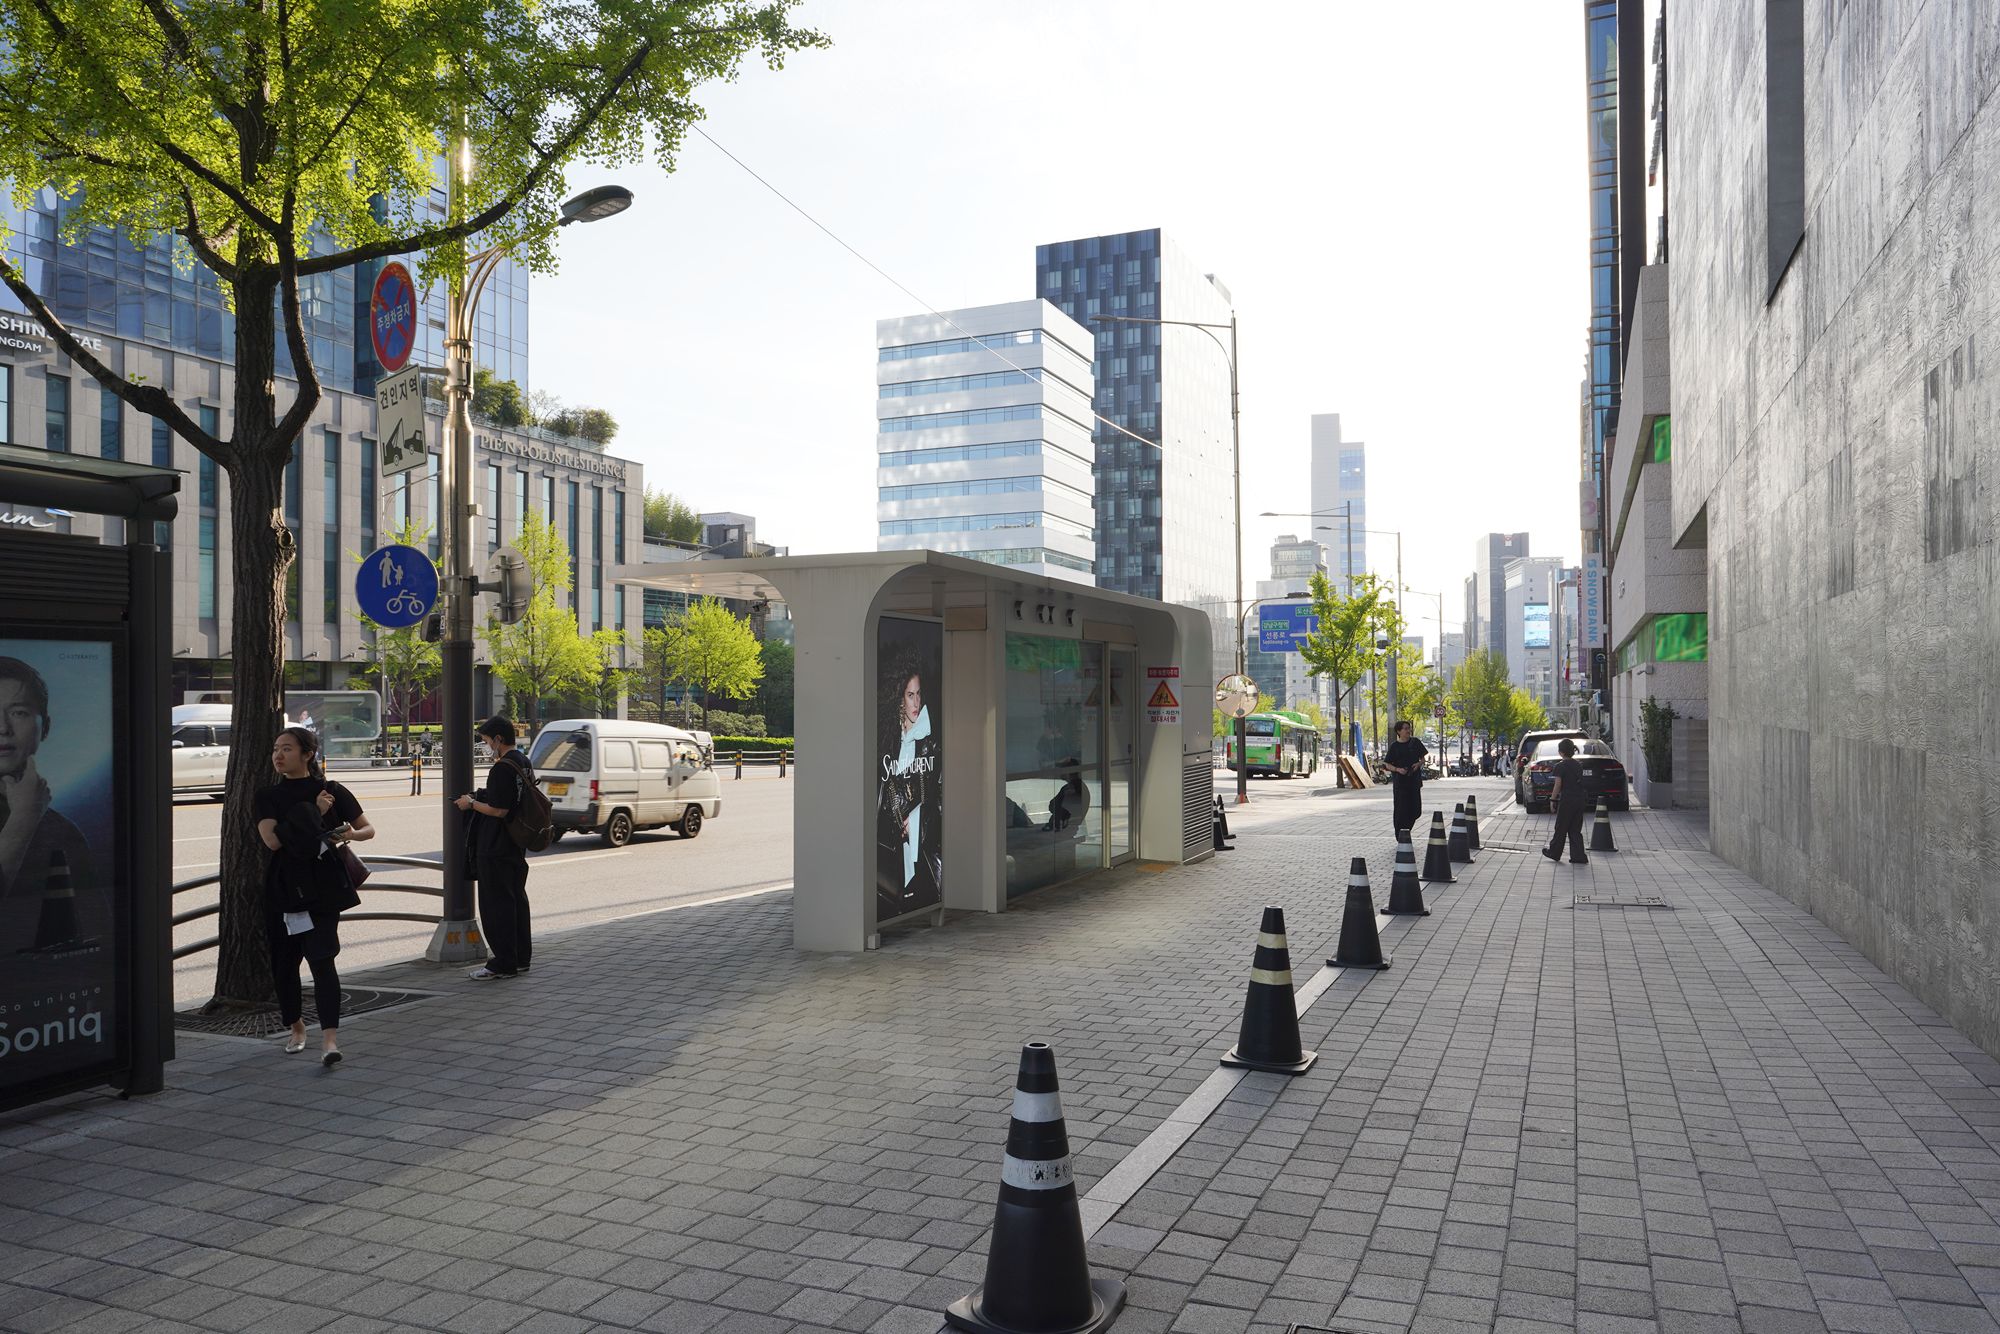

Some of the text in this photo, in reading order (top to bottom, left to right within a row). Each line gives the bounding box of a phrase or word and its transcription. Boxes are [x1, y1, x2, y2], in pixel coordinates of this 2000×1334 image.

[377, 300, 410, 332] 주정차금지
[380, 375, 419, 410] 견인지역
[480, 434, 627, 479] PIEN POLUS RESIDENCE
[1587, 570, 1598, 643] SNOWBANK
[34, 986, 101, 1007] unique
